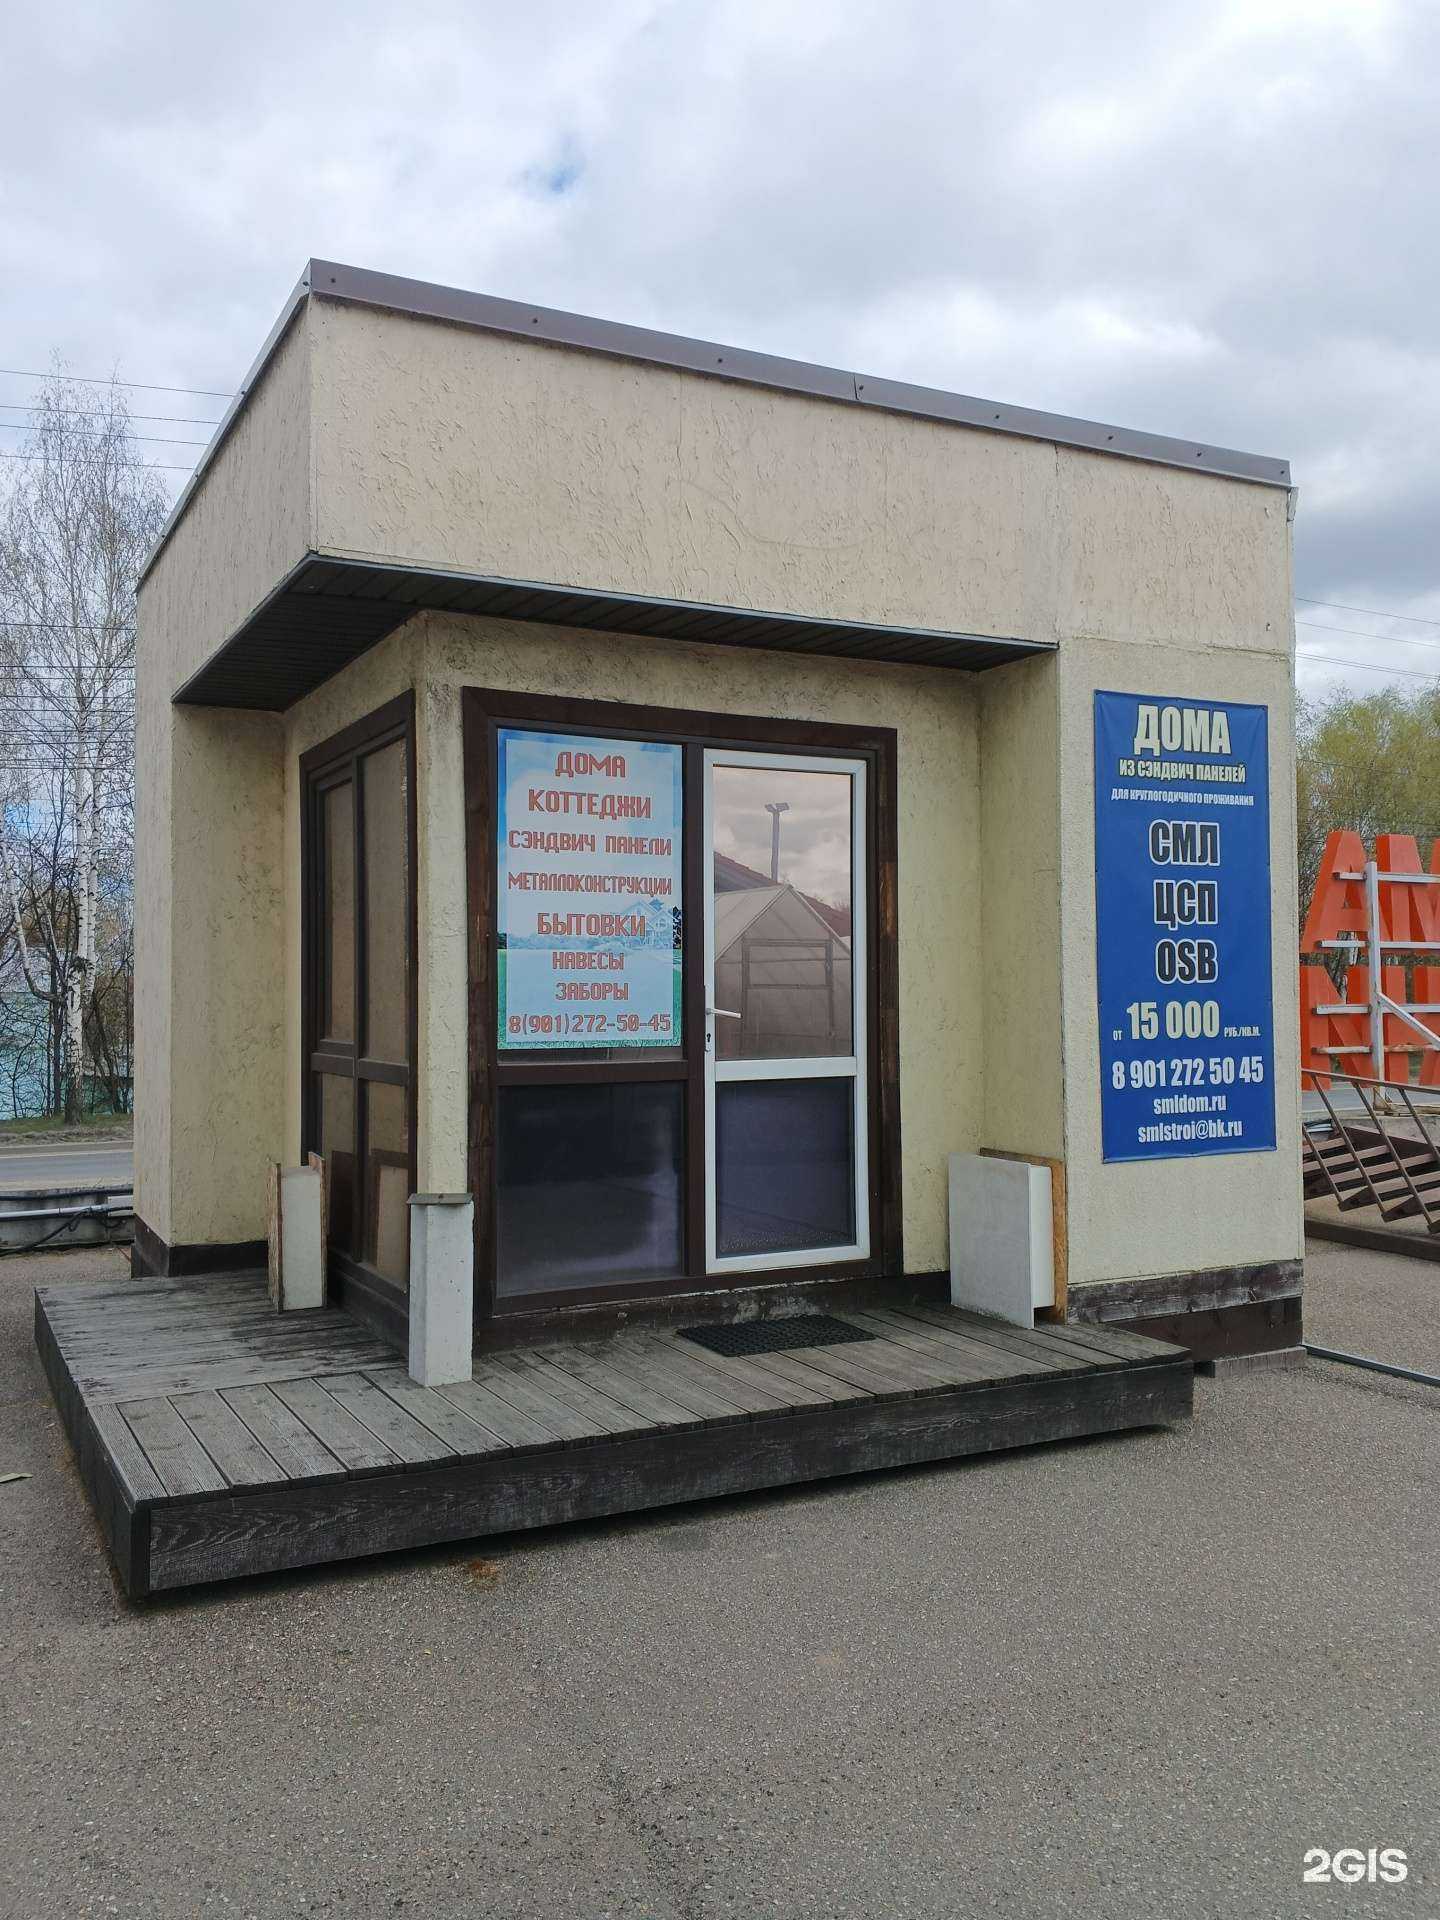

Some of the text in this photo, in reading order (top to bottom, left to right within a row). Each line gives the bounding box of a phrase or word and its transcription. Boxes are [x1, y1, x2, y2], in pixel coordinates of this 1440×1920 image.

[1134, 704, 1231, 756] ДОМА
[555, 751, 626, 778] ДОМА
[1119, 758, 1246, 783] ИЗ СЭНДВИЧ ПАНЕЛЕЙ
[528, 789, 651, 820] КОТТЕДЖИ
[1111, 788, 1254, 806] ДЛЯ КРУГЛОГОДИЧНОГО ПРОЖИВАНИЯ
[508, 830, 672, 856] СЭНДВИЧ ПАНЕЛИ
[1149, 818, 1220, 866] СМЛ
[508, 871, 672, 897] МЕТАЛЛОКОНСТРУКЦИИ
[1154, 879, 1218, 930] ЦСП
[537, 912, 646, 937] БЫТОВКИ
[552, 951, 624, 970] НАВЕСЫ
[1155, 938, 1218, 984] OSB
[555, 982, 628, 1001] ЗАБОРЫ
[508, 1013, 672, 1035] 8(901)272-50-45
[1112, 1055, 1264, 1090] 8 901 272 50 45
[1153, 1095, 1227, 1115] smldom.ru
[1137, 1120, 1243, 1144] smlstroi@bk.ru
